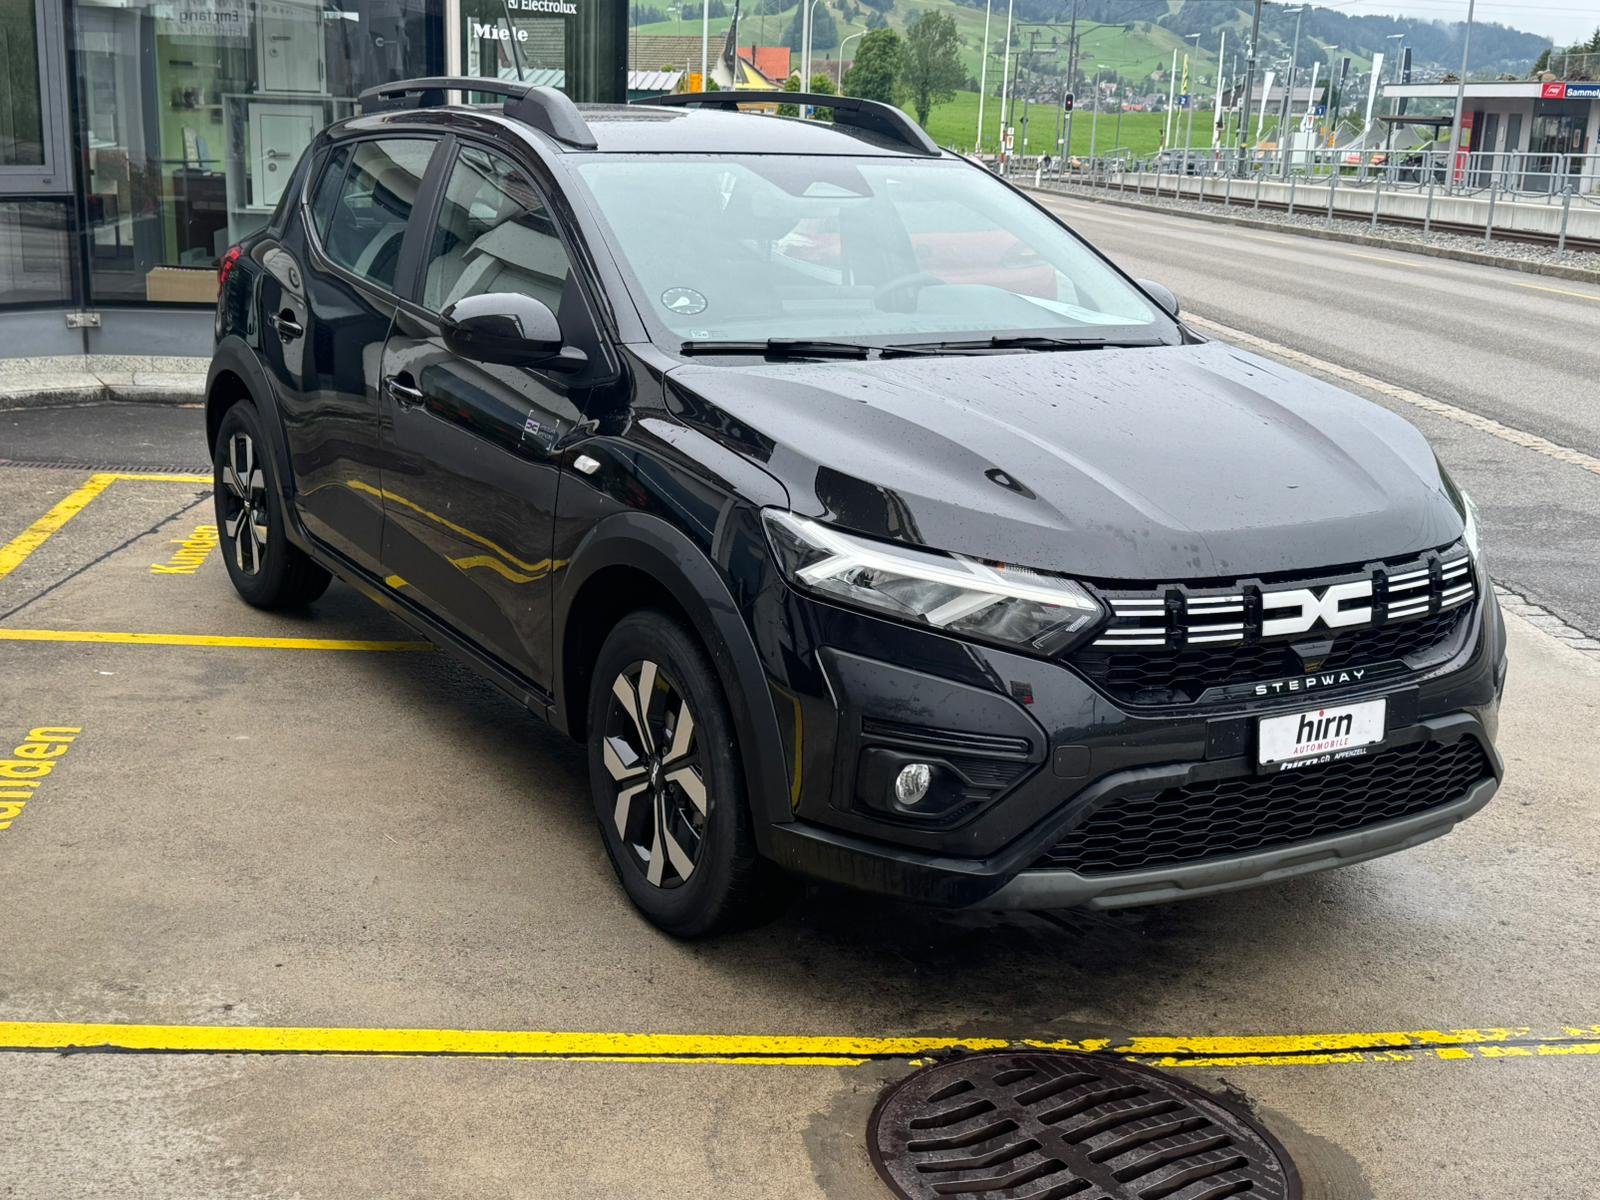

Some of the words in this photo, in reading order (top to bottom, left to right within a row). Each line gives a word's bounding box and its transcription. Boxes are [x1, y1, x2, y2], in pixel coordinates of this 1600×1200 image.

[521, 0, 577, 14] Electrolux
[473, 23, 528, 41] Miele
[1255, 669, 1364, 695] STEPWAY
[1296, 708, 1353, 744] hirn
[1293, 737, 1349, 755] AUTOMOBILE
[1334, 747, 1367, 760] APPENZELL
